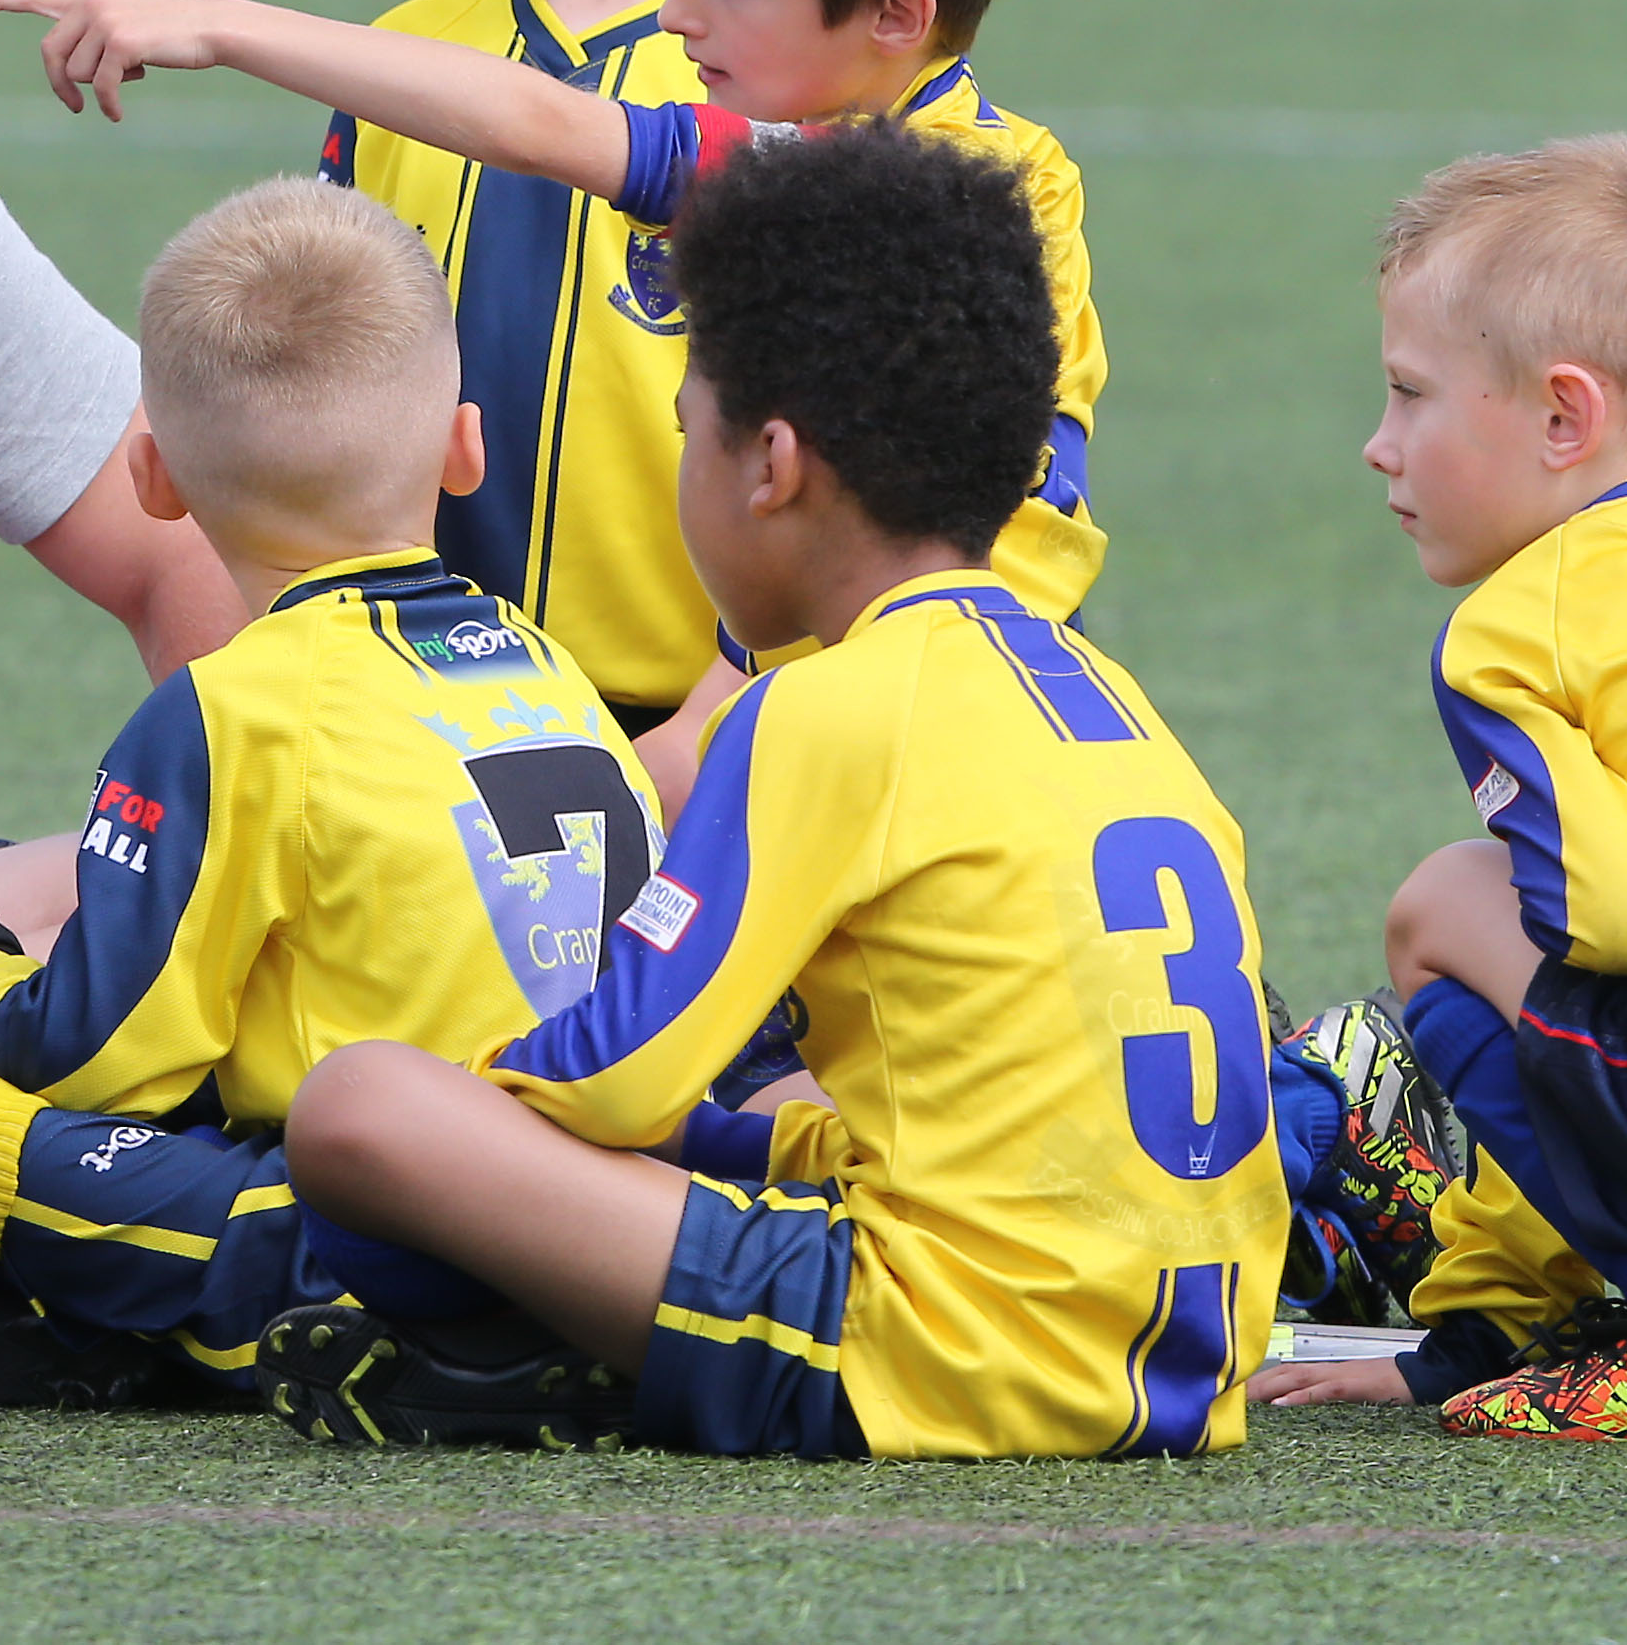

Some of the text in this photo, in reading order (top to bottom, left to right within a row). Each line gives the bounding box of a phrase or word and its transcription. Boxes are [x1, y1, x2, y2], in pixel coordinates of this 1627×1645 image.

[81, 817, 149, 874] ALL
[97, 780, 165, 834] FOR
[461, 740, 653, 996] 7
[1093, 817, 1269, 1179] 3
